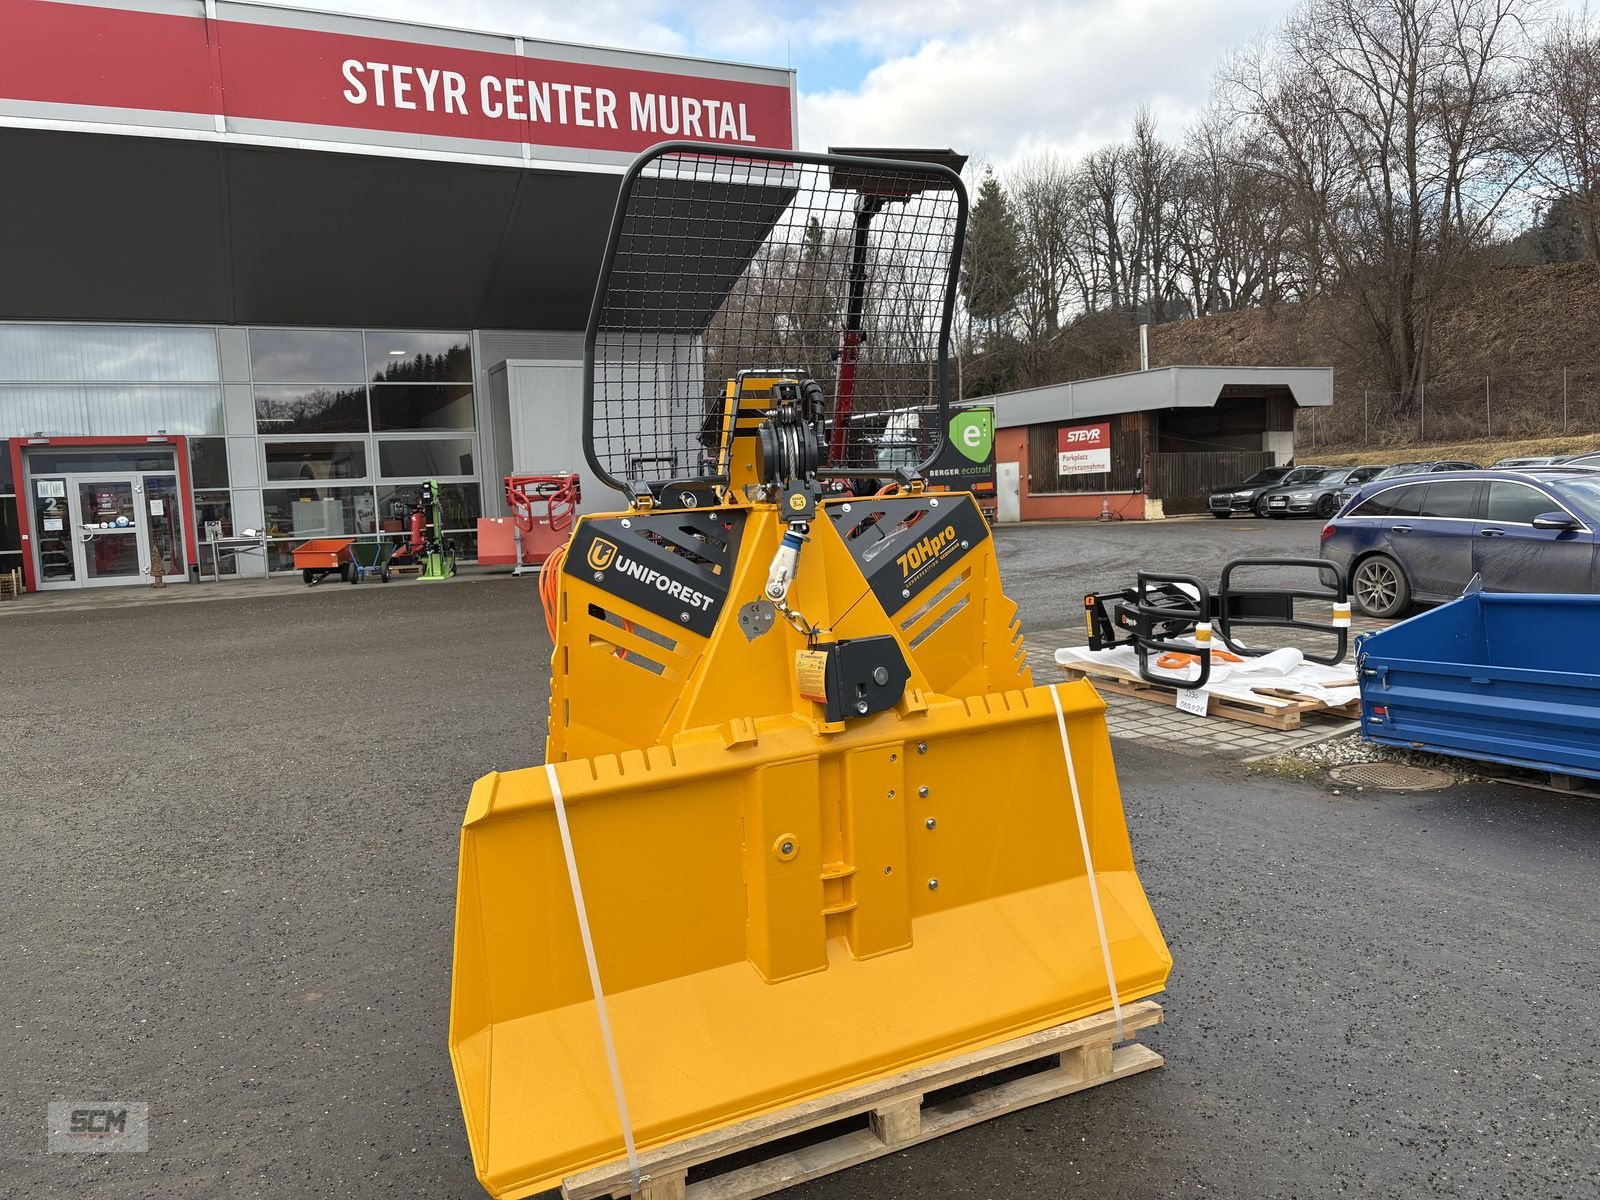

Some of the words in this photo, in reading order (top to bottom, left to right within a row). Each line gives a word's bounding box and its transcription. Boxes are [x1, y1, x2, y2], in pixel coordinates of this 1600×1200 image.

[341, 59, 469, 115] STEYR
[480, 75, 619, 129] CENTER
[630, 91, 757, 142] MURTAL
[1066, 428, 1101, 443] STEYR
[1062, 454, 1088, 463] Parkplatz
[929, 468, 960, 477] BERGER
[1062, 463, 1105, 472] Direktannahme
[45, 497, 58, 511] 2
[896, 525, 956, 578] 70Hpro
[615, 554, 715, 612] UNIFOREST
